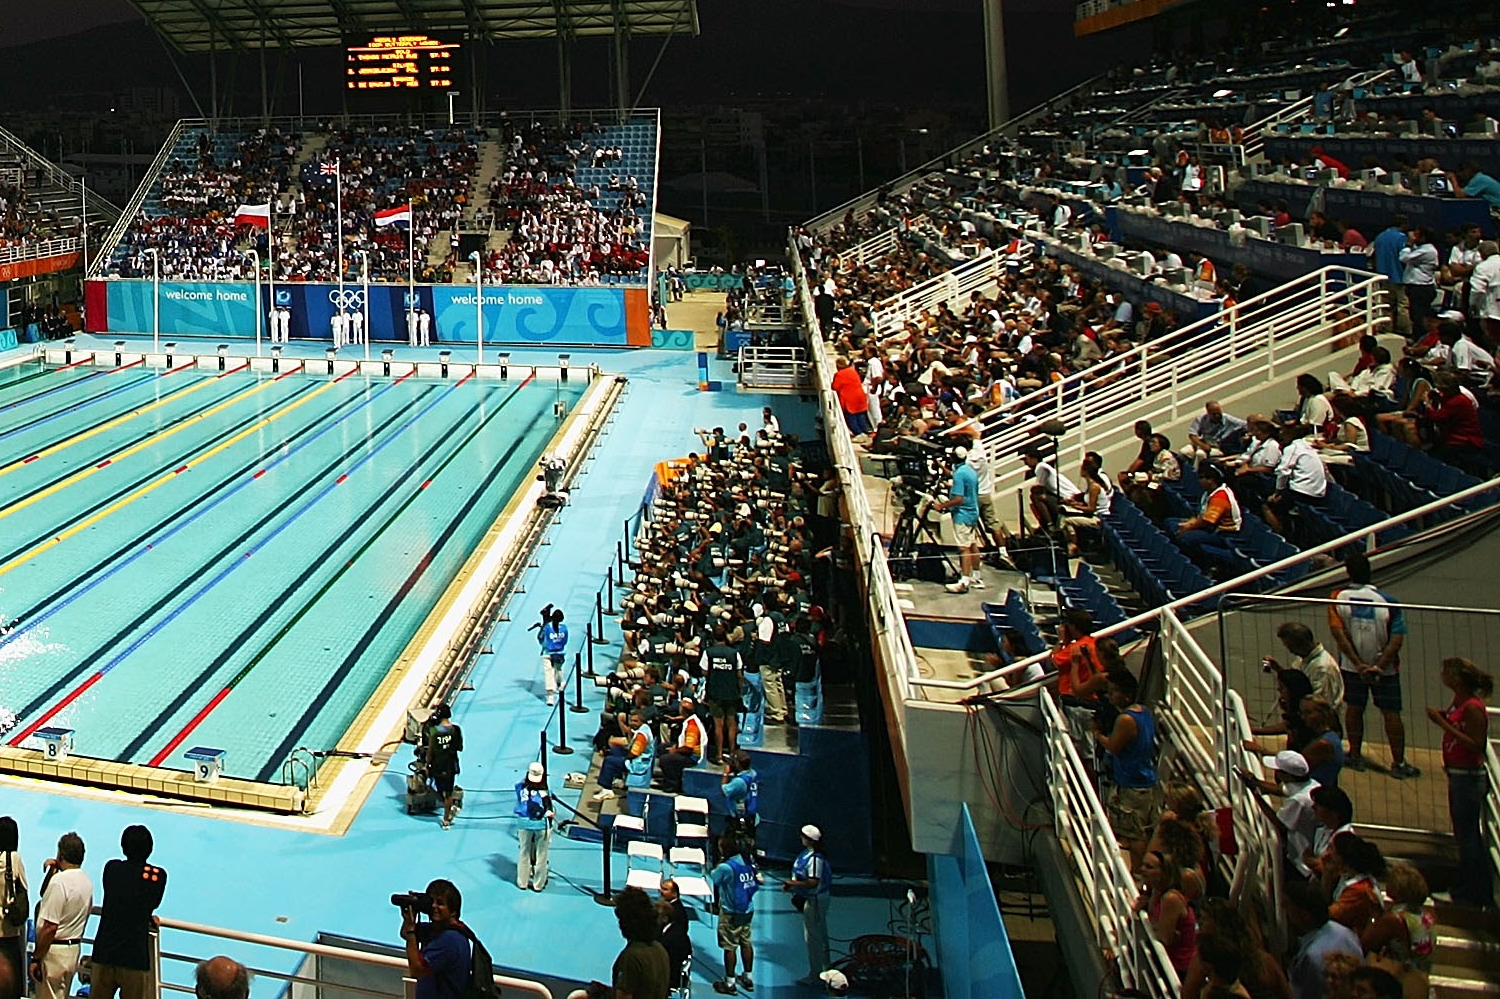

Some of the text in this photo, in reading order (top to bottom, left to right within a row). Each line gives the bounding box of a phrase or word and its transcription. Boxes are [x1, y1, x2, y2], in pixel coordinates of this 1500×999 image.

[166, 289, 247, 300] welcome home
[508, 293, 543, 305] home
[48, 744, 56, 757] 8
[200, 765, 208, 778] 9
